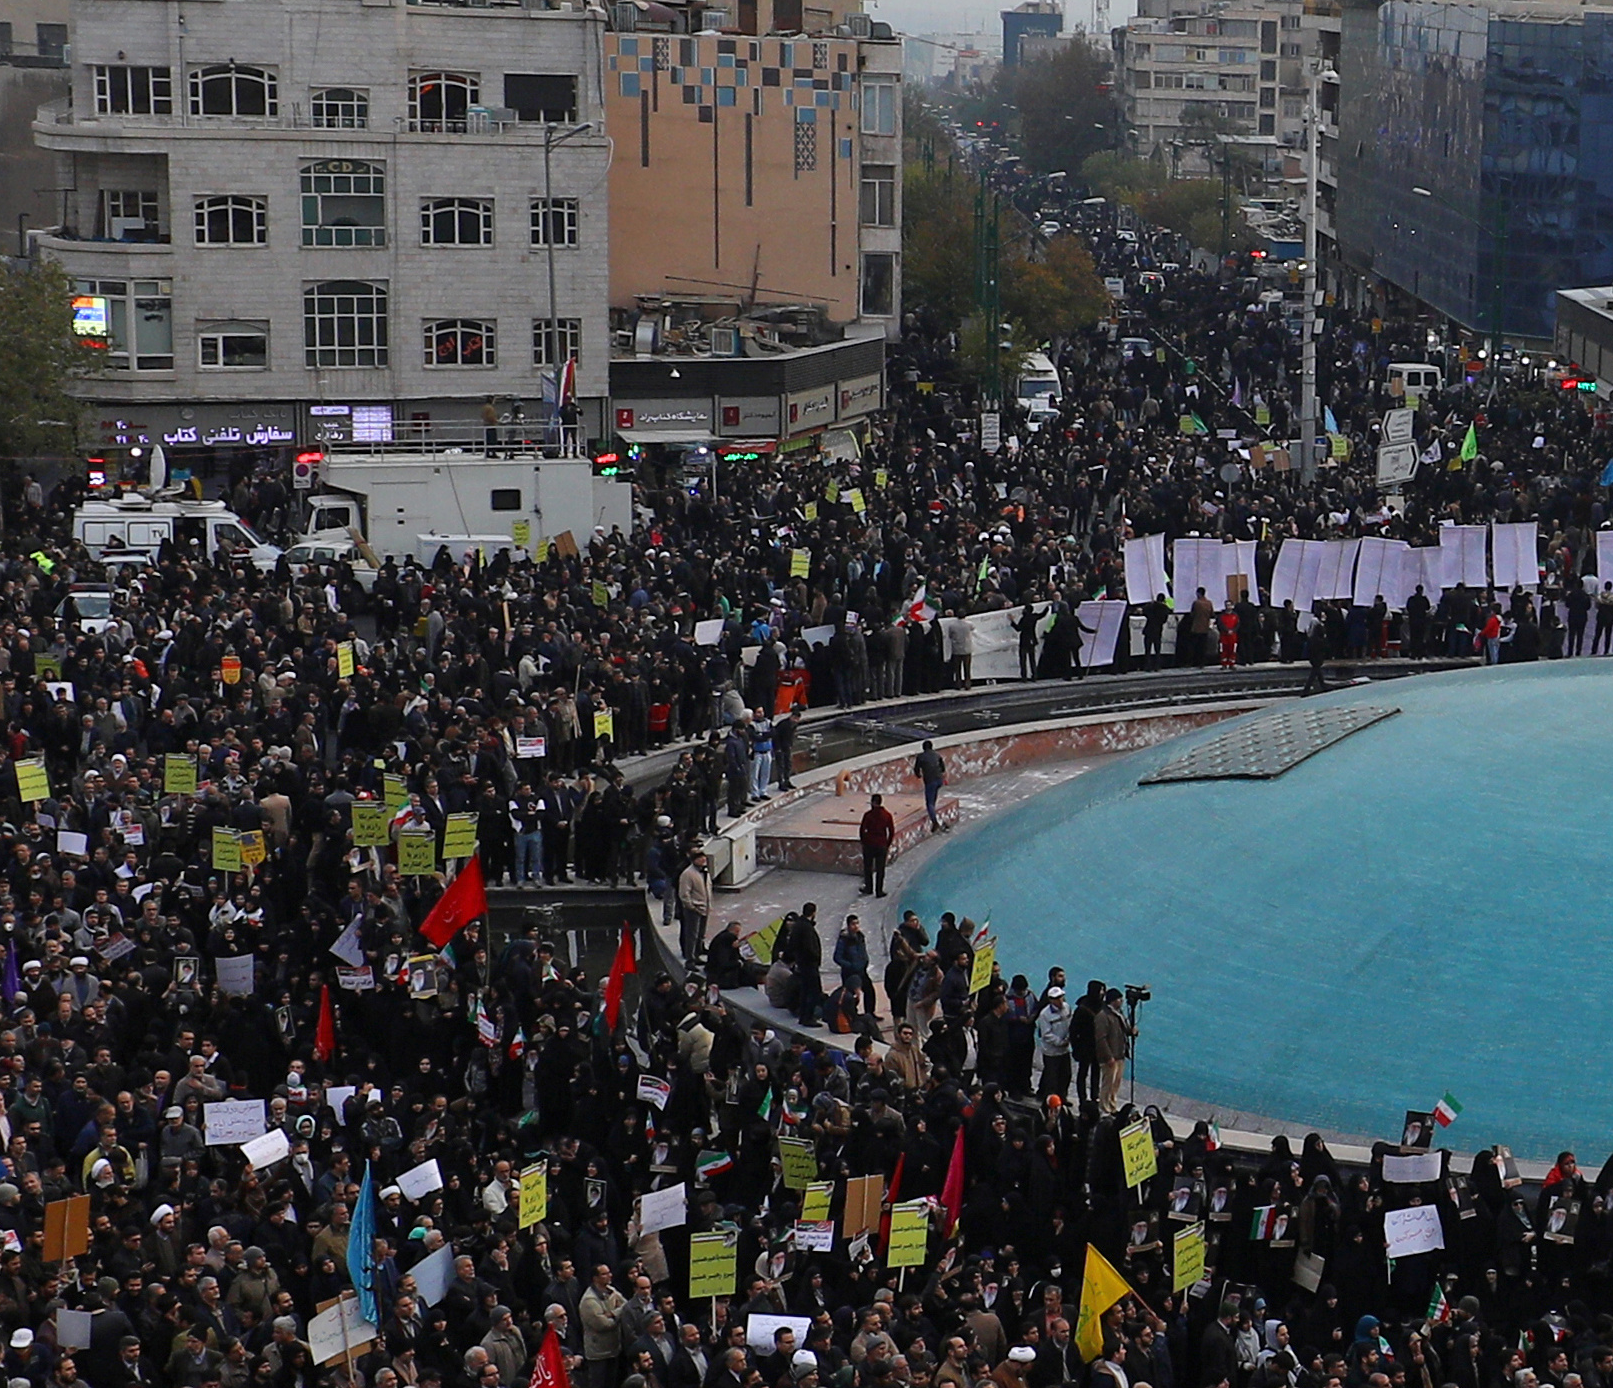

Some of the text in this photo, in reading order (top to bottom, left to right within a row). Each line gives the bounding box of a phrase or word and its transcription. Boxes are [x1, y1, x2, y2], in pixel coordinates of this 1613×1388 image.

[163, 426, 198, 446] کتاب
[202, 426, 241, 446] تلفنی
[245, 424, 293, 446] سفارش
[152, 530, 164, 539] TV
